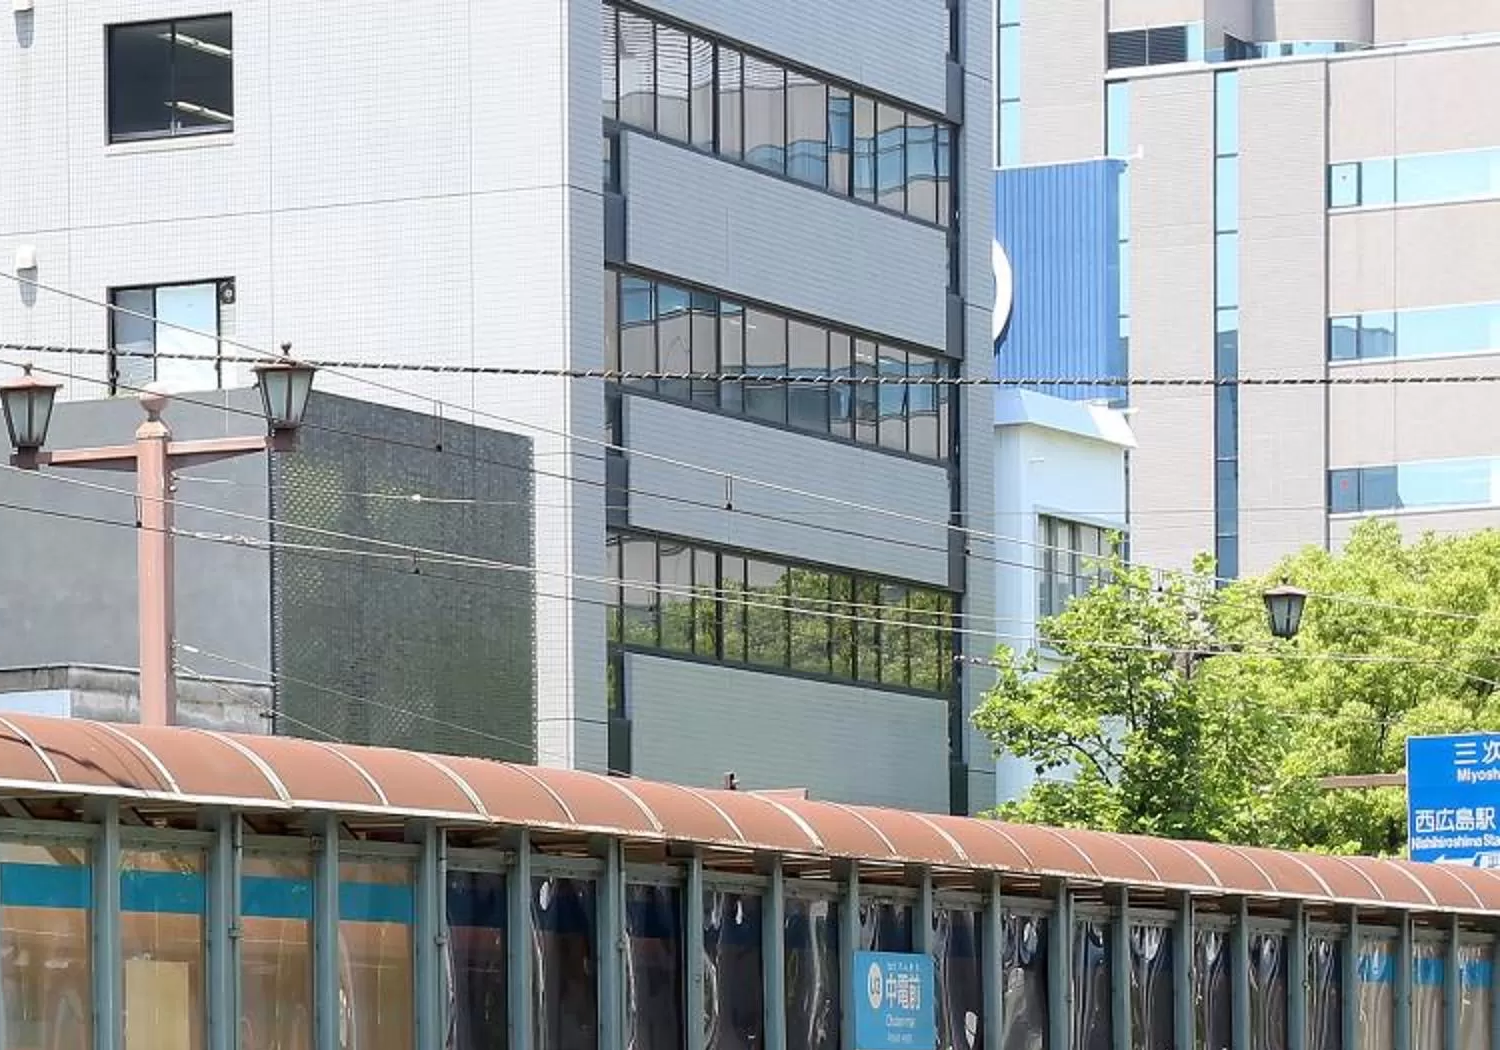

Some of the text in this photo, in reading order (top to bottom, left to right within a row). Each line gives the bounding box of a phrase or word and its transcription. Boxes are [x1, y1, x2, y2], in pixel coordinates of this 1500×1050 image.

[1453, 740, 1500, 765] 三次
[1415, 807, 1497, 833] 西広島駅
[886, 972, 921, 1011] 中電前
